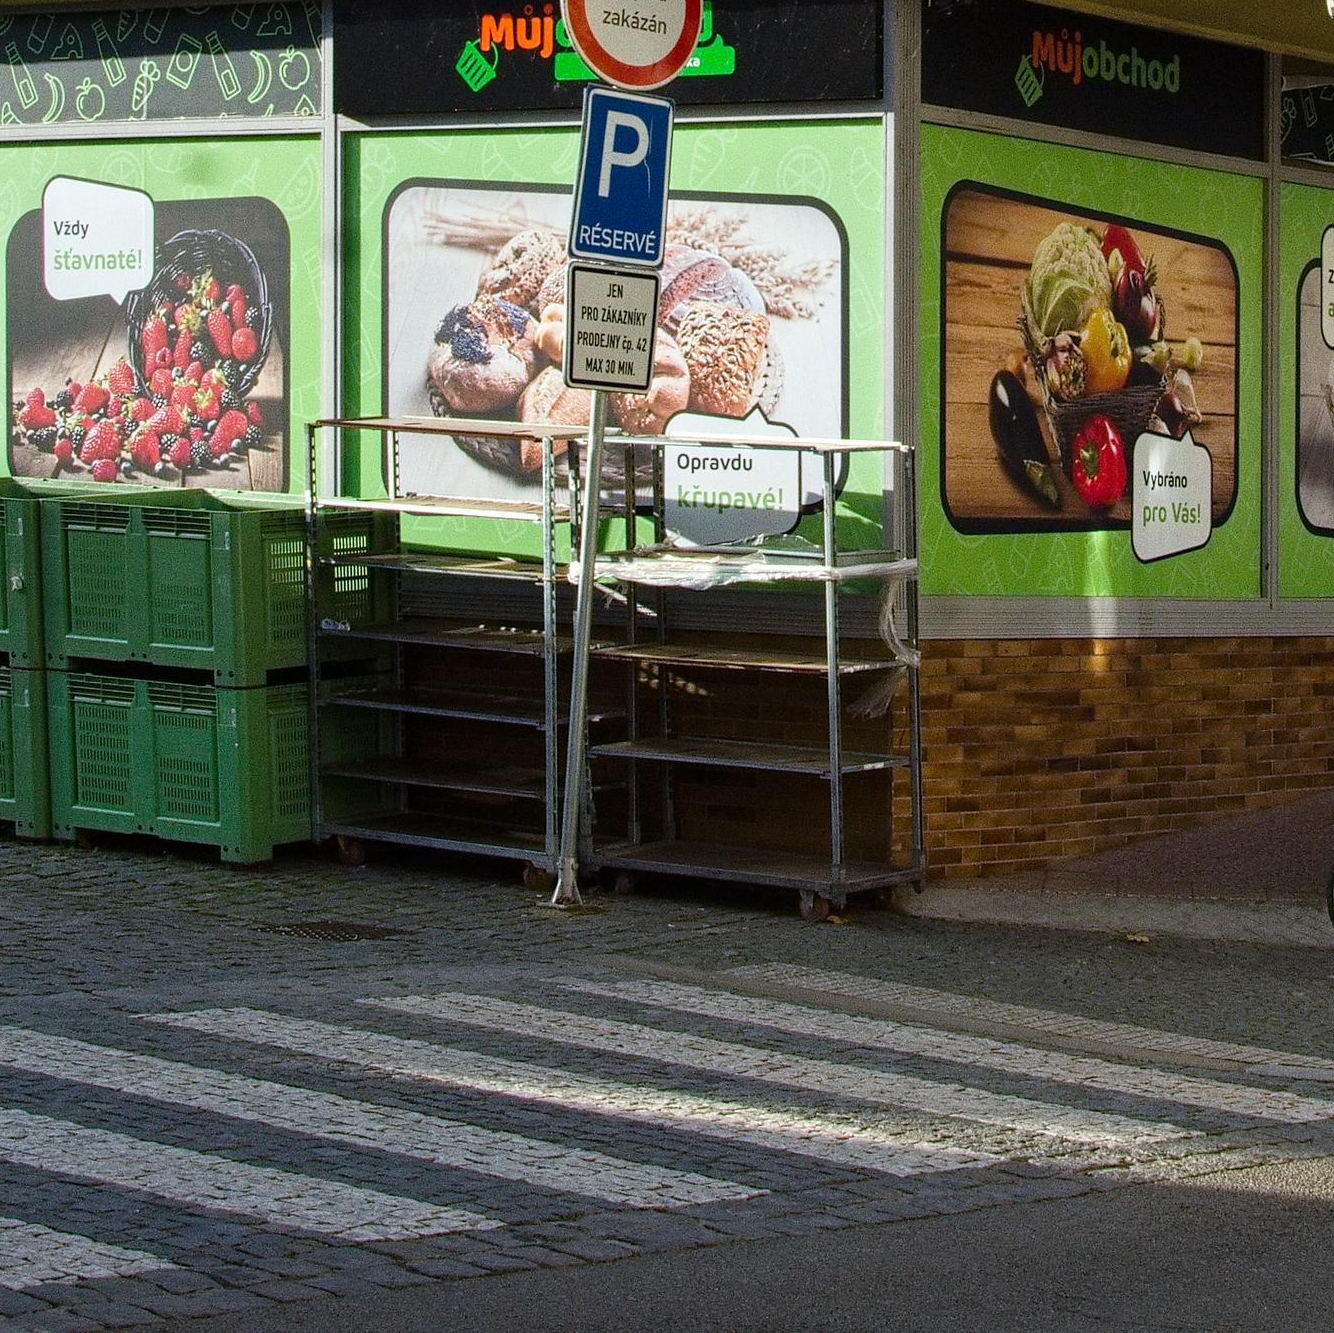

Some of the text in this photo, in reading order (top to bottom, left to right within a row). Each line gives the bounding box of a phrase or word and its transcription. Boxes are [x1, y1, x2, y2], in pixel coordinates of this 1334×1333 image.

[602, 8, 667, 35] zakázán
[597, 110, 650, 198] P
[53, 219, 89, 240] Vždy
[579, 222, 657, 255] RÉSERVÉ
[53, 247, 142, 271] šťavnaté!
[606, 283, 624, 299] JEN
[581, 305, 648, 326] PRO ZÁKAZNÍKY
[577, 330, 621, 349] PRODEJNY
[636, 338, 648, 352] 42
[585, 357, 636, 376] MAX 30 MIN.
[676, 453, 753, 473] Opravdu
[1142, 470, 1188, 490] Vybráno
[677, 485, 784, 514] křupavé!
[1143, 502, 1201, 527] pro Vás!
